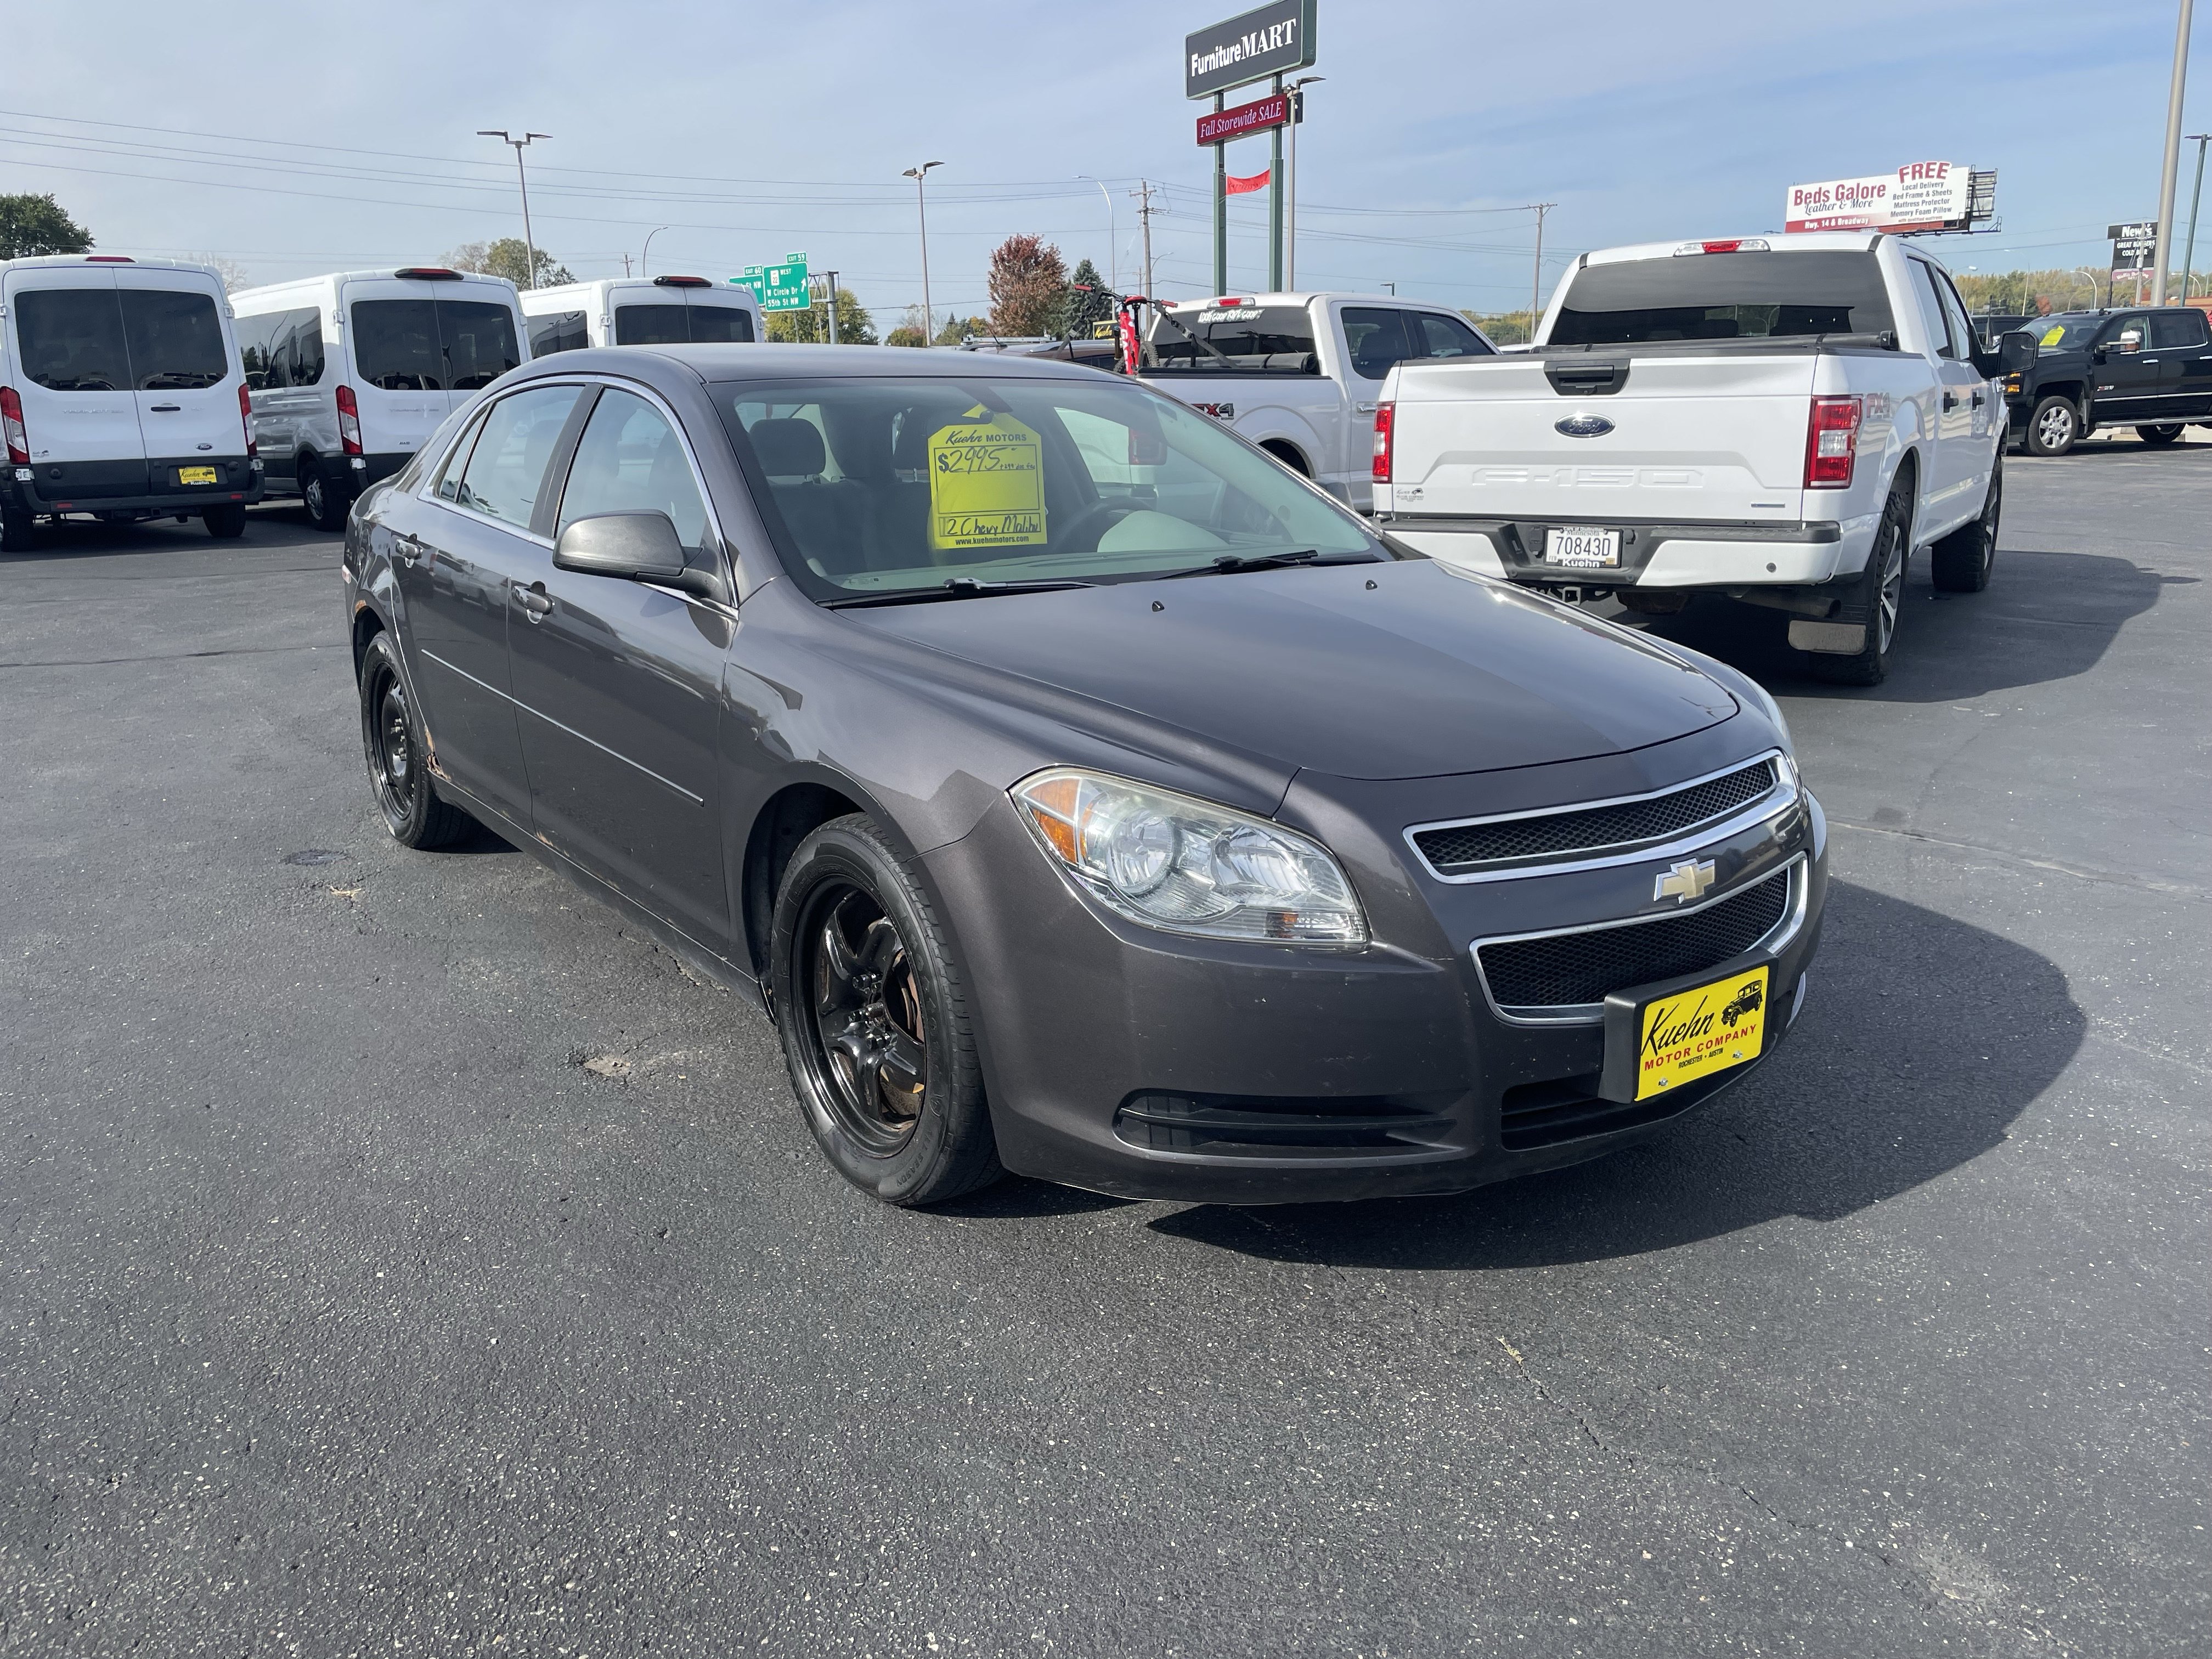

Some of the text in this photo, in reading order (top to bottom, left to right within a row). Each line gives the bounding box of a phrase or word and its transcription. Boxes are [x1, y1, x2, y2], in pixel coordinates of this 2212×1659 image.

[1191, 18, 1296, 77] FurnitureMART
[1200, 101, 1282, 138] Fall Storewide SALE
[1899, 162, 1950, 184] FREE
[1794, 183, 1886, 206] Beds Galore
[1921, 198, 1950, 206] Protector
[1804, 199, 1873, 216] Leather & More
[1804, 221, 1820, 229] Hwy.
[1837, 217, 1869, 225] Broadway
[2121, 223, 2152, 238] New's
[753, 281, 761, 289] NW
[774, 288, 789, 296] Circle
[768, 299, 780, 307] 55th
[1095, 325, 1112, 338] Kuehn
[1866, 392, 1890, 418] FX4
[1568, 419, 1602, 432] Ford
[945, 430, 1027, 445] Kuehn MOTORS
[181, 469, 200, 478] Kuehn
[1472, 467, 1704, 488] F-150
[961, 518, 998, 536] Chevy
[1002, 515, 1038, 533] Malibu
[956, 536, 1029, 545] www.kuehnmotors.com
[1556, 537, 1611, 556] 70843D
[1562, 558, 1600, 568] Kuehn
[1641, 995, 1715, 1057] Kuehn
[1644, 1024, 1756, 1071] MOTOR COMPANY
[1678, 1047, 1724, 1069] ROCHESTER AUSTIN
